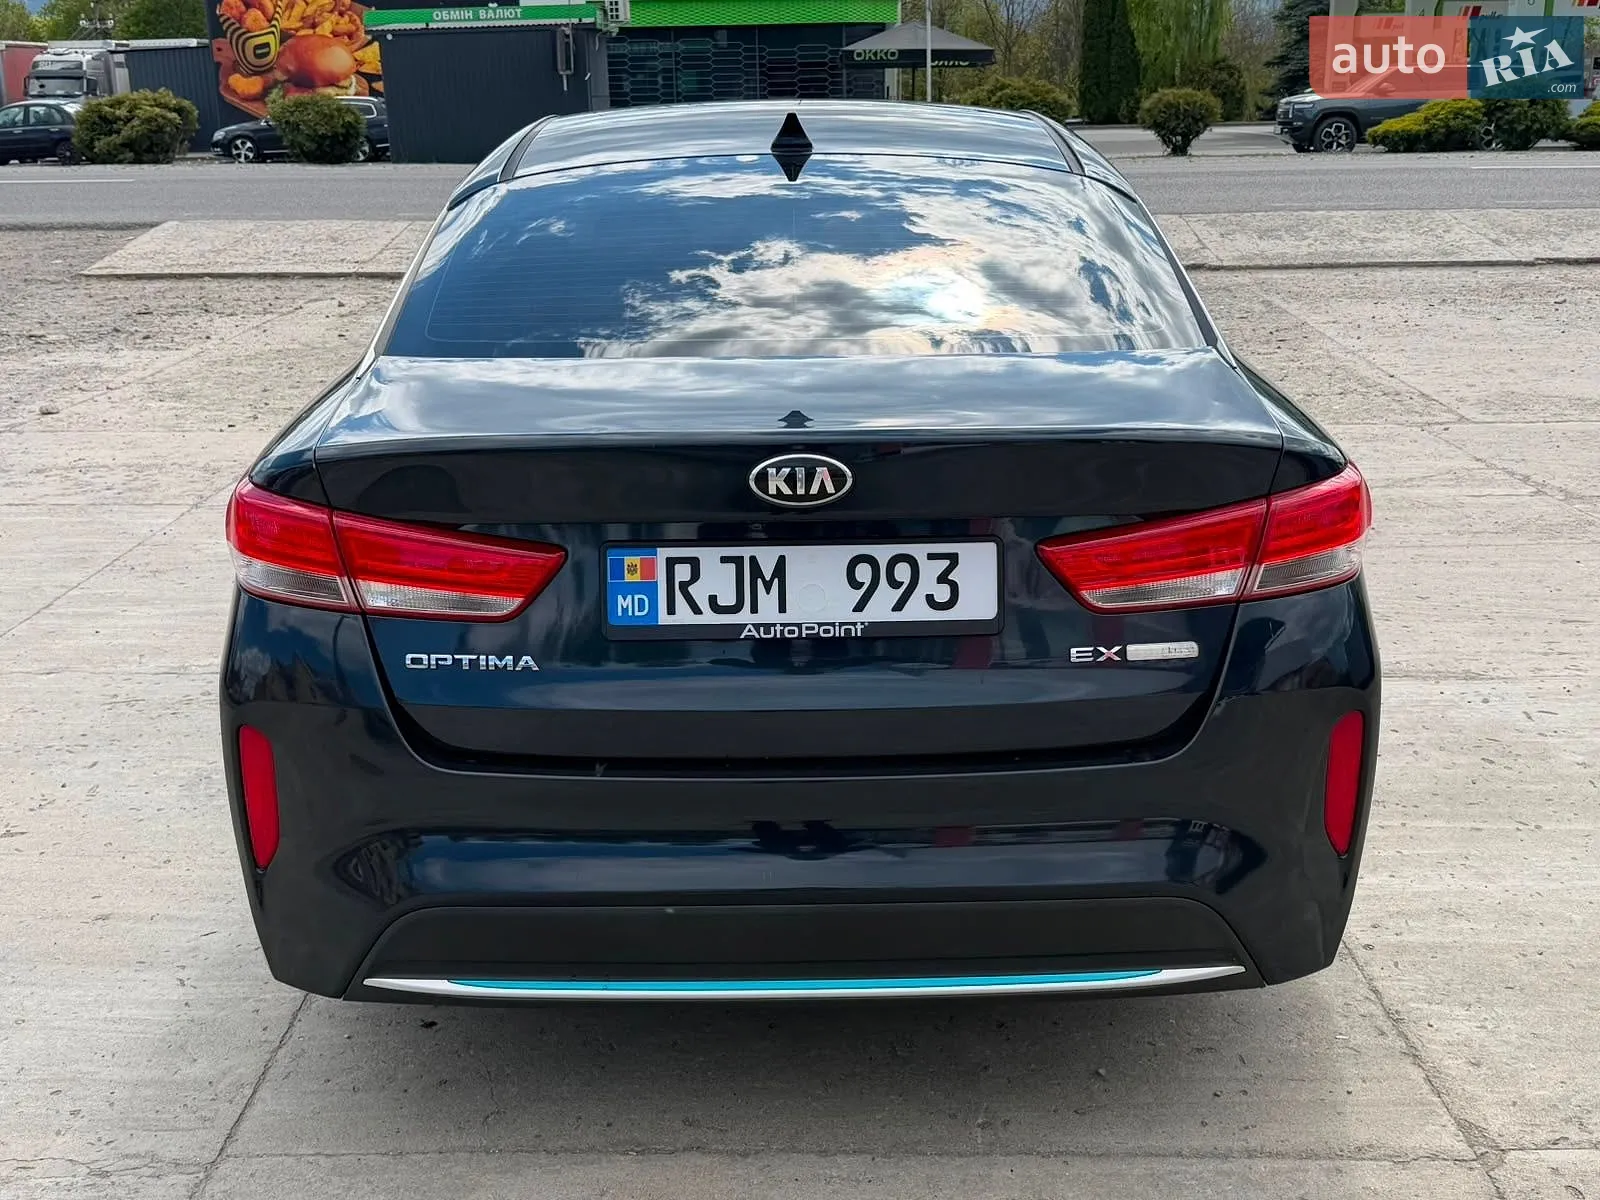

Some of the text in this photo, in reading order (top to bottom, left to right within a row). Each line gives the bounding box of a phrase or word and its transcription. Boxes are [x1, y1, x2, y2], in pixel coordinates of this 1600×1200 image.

[432, 9, 522, 20] ОБМІН ВАЛЮТ
[853, 48, 899, 61] OKKO
[767, 467, 836, 495] KIA
[665, 552, 961, 616] RJM 993
[616, 594, 650, 617] MD
[405, 653, 540, 671] OPTIMA
[1070, 646, 1122, 662] EX
